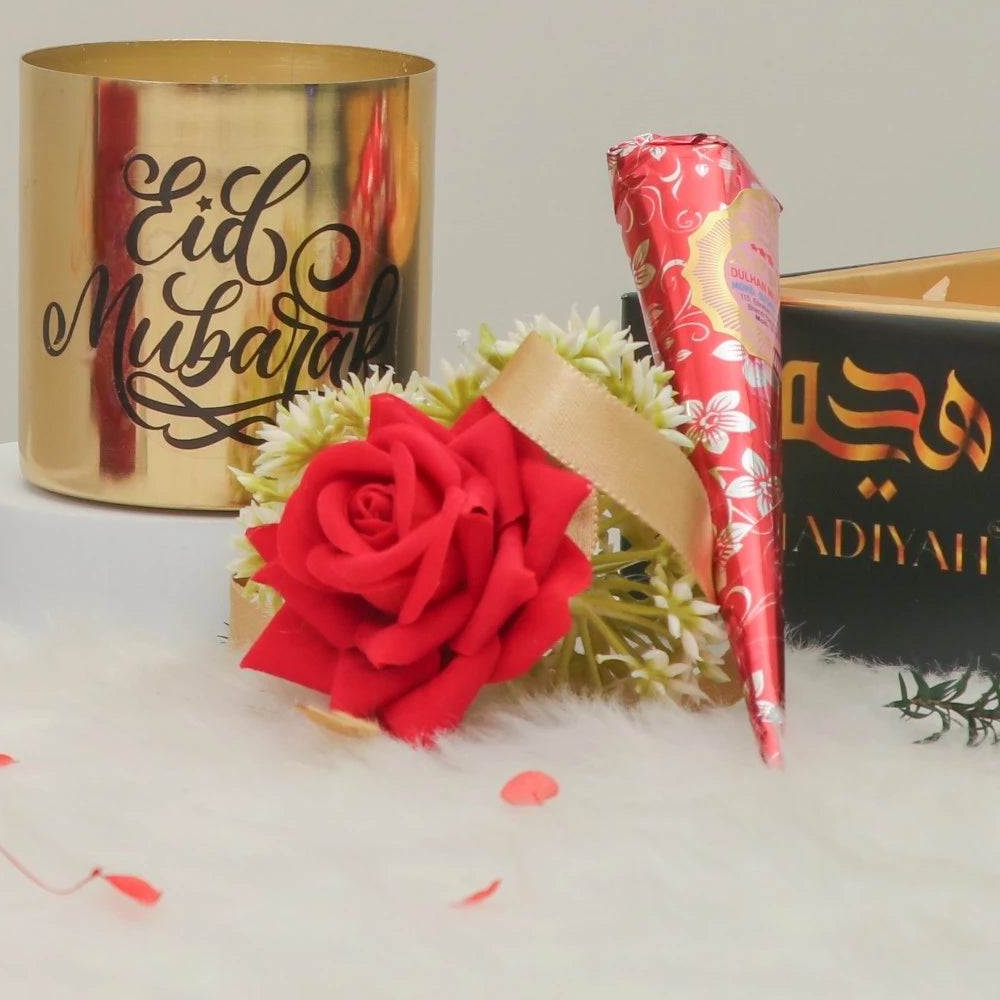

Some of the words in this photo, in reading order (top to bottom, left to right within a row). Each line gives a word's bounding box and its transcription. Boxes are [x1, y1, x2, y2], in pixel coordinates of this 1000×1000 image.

[123, 153, 311, 286] Eid
[730, 267, 767, 292] DULHAN
[43, 223, 400, 449] Mubarak
[782, 512, 988, 576] ADIYAH
